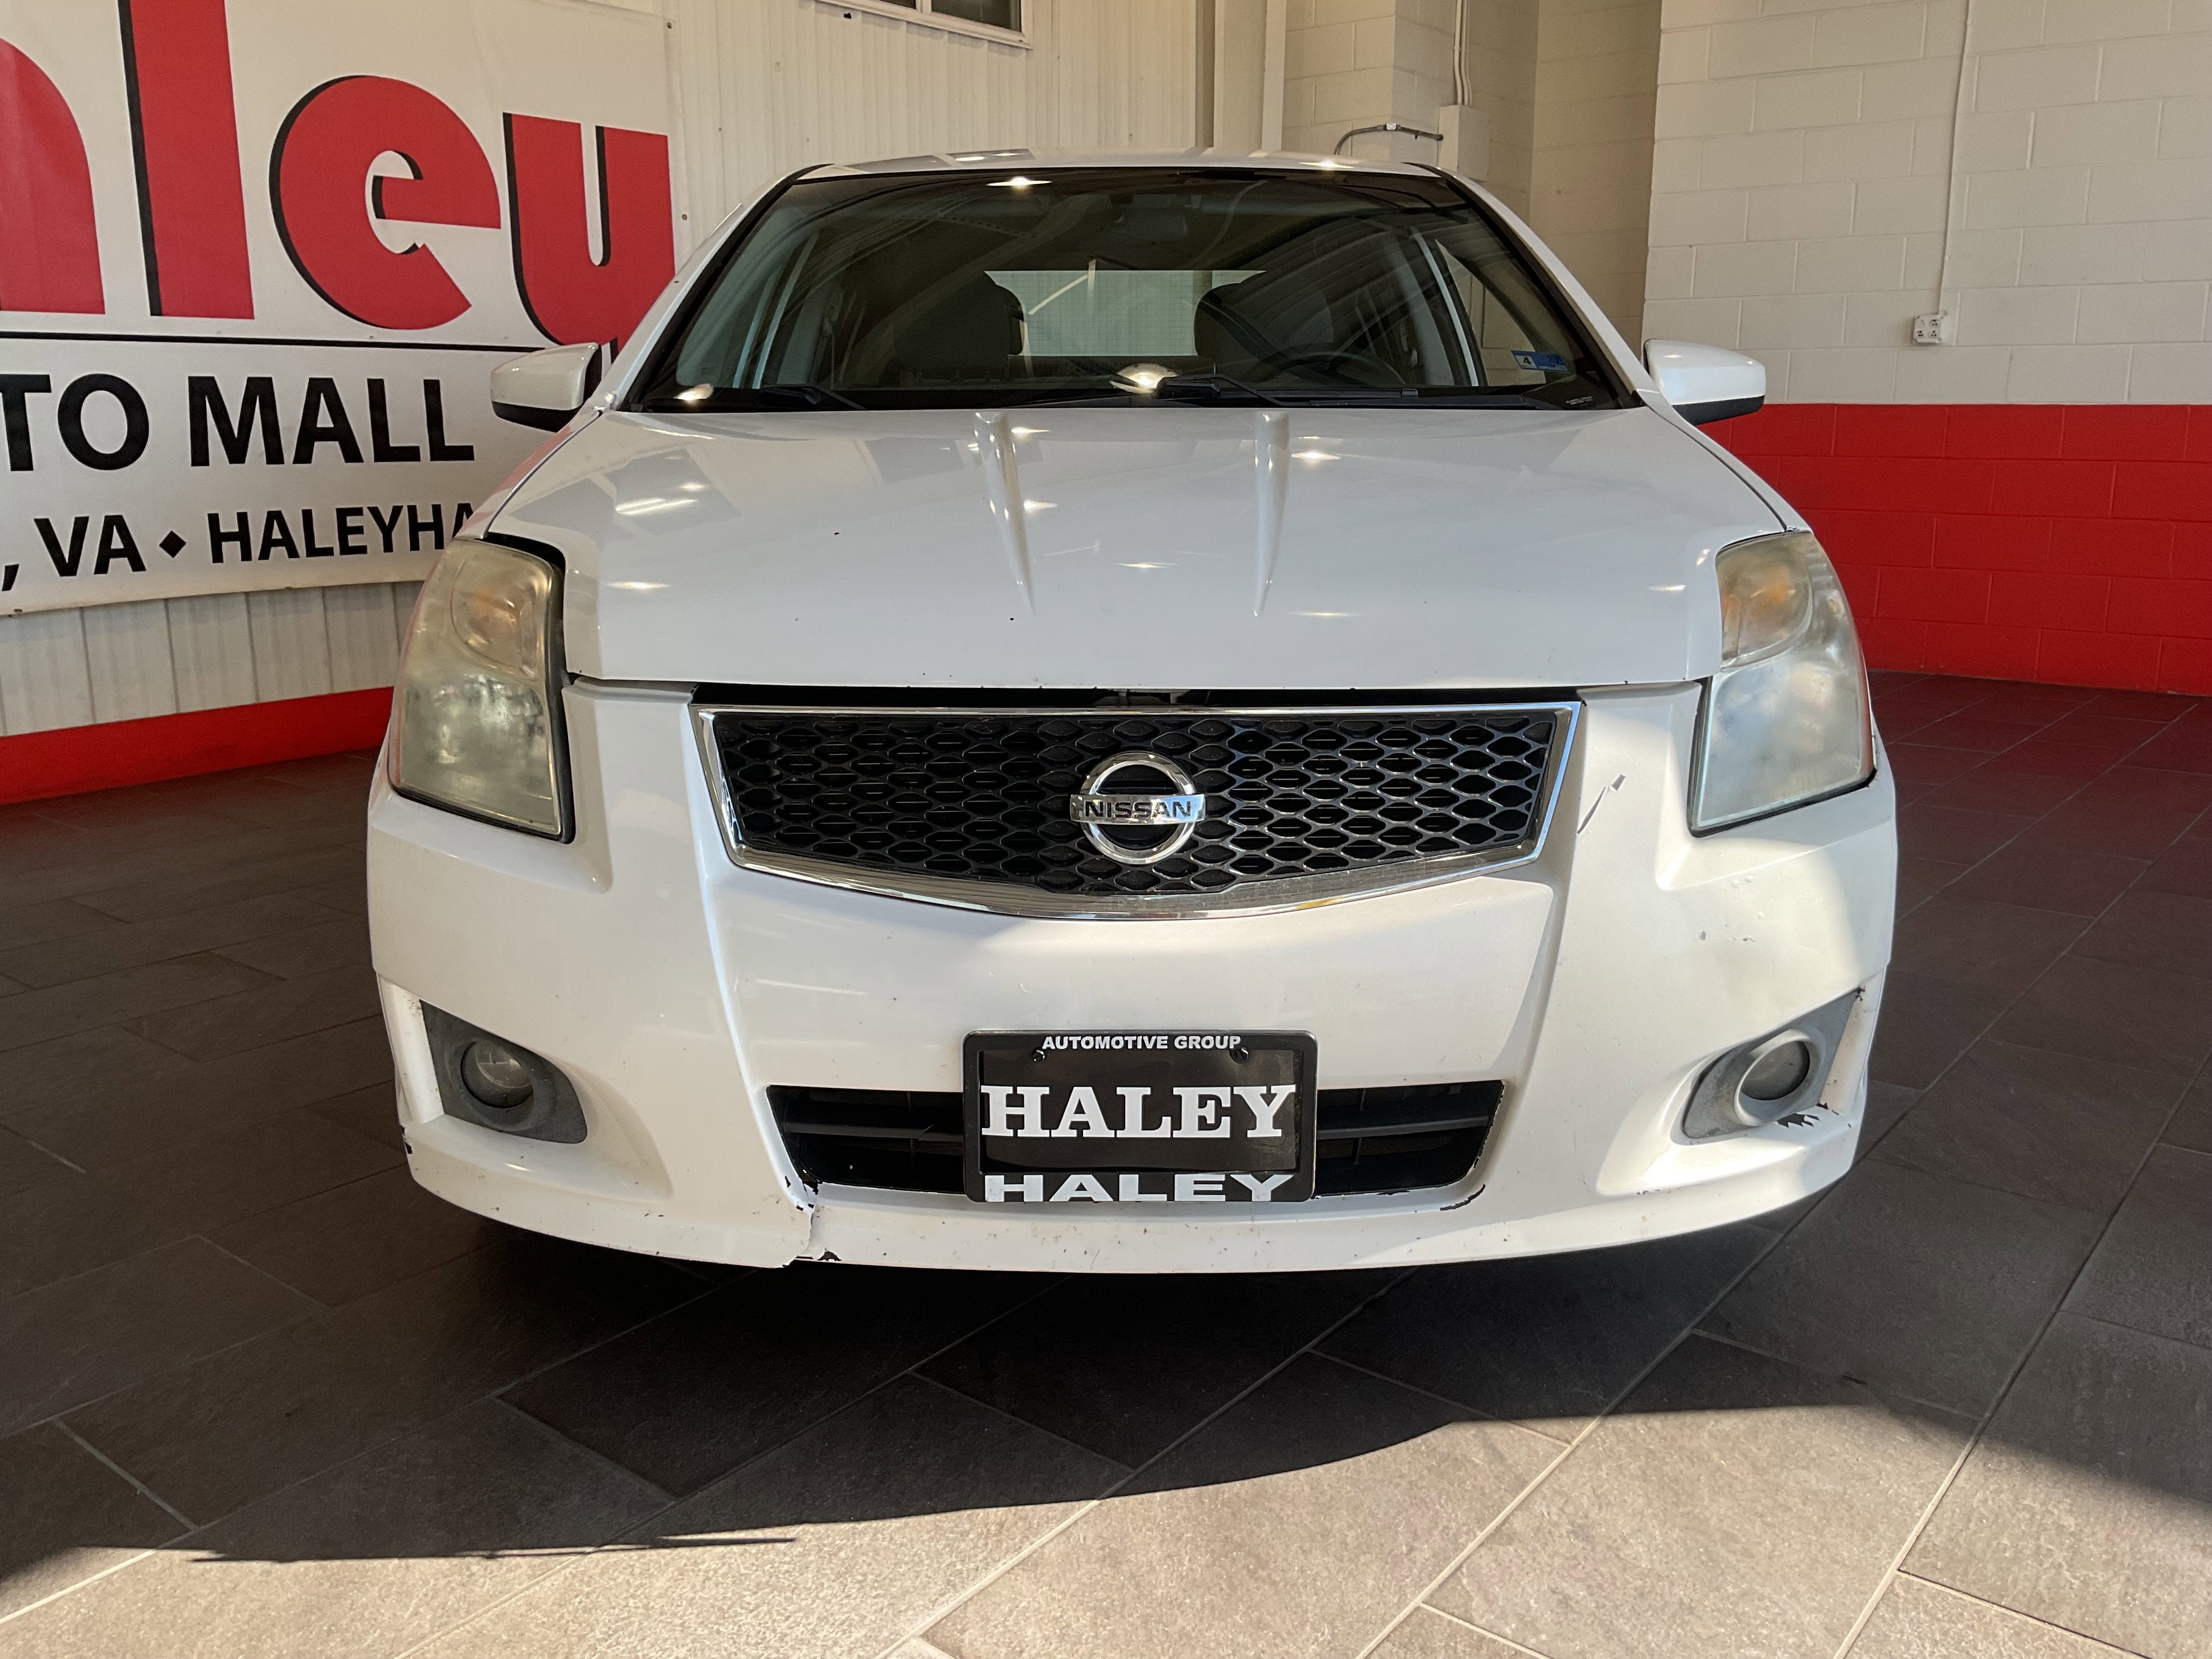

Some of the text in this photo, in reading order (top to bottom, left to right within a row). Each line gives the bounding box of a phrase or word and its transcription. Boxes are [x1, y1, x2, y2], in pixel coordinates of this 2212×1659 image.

[188, 376, 475, 467] MALL
[33, 515, 146, 577] VA
[1085, 801, 1191, 819] NISSAN
[1042, 1035, 1242, 1050] AUTOMOTIVE GROUP
[980, 1084, 1297, 1138] HALEY
[984, 1173, 1294, 1203] HALEY
